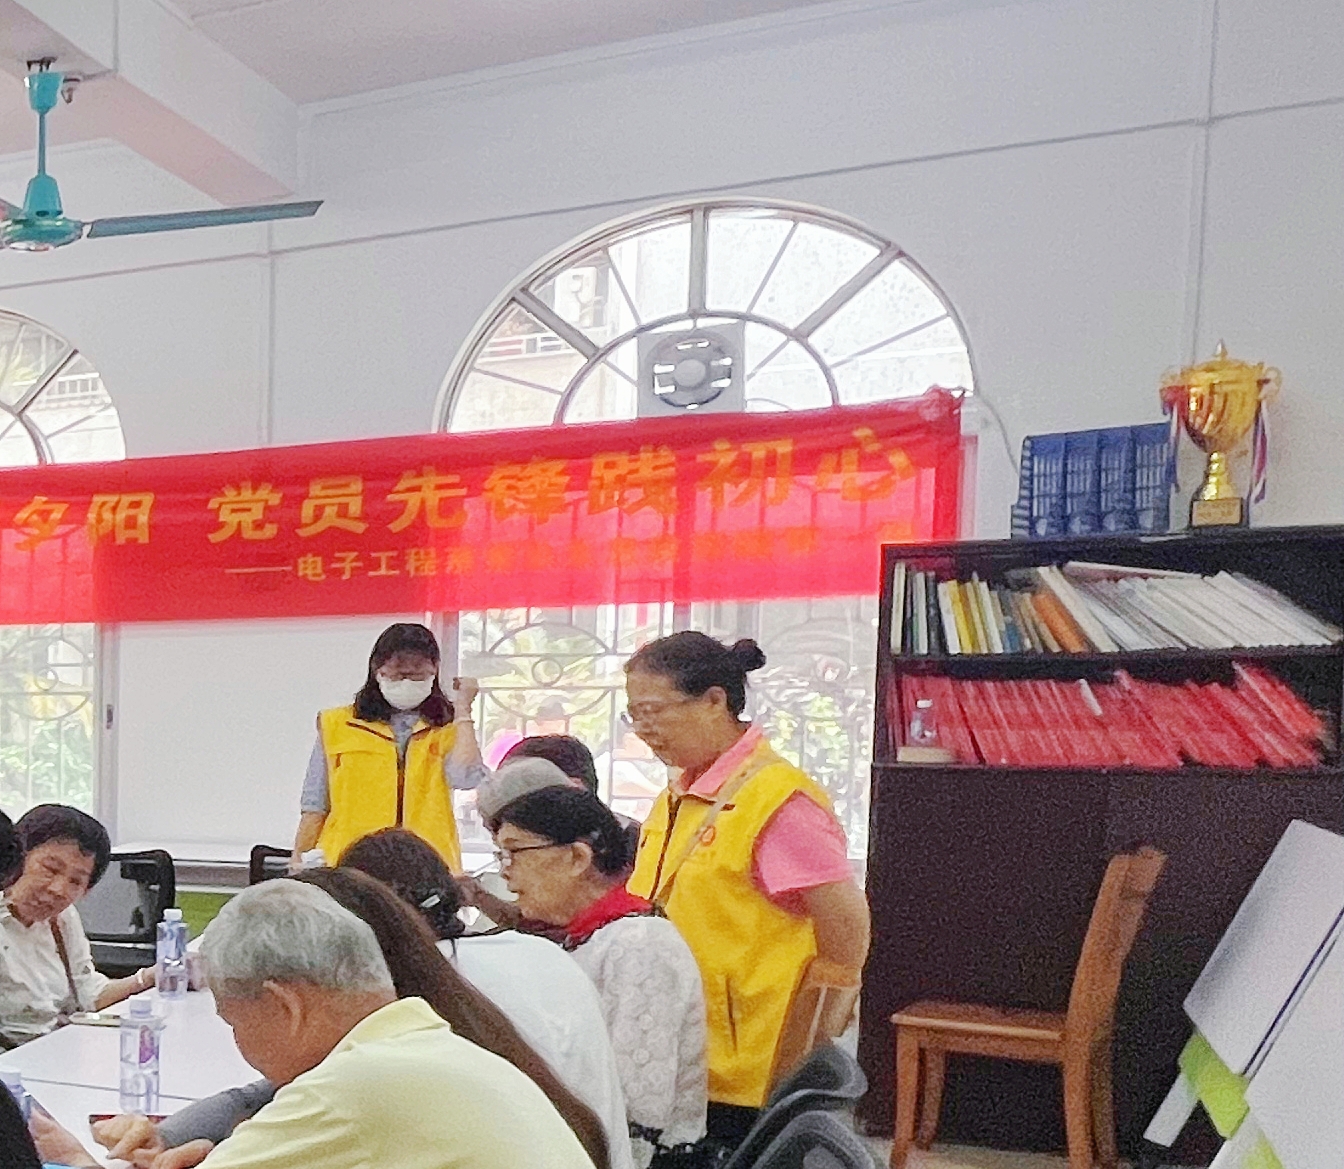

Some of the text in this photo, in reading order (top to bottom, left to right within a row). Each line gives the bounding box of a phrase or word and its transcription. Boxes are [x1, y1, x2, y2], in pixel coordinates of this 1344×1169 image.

[206, 426, 917, 545] 党员先锋践初心
